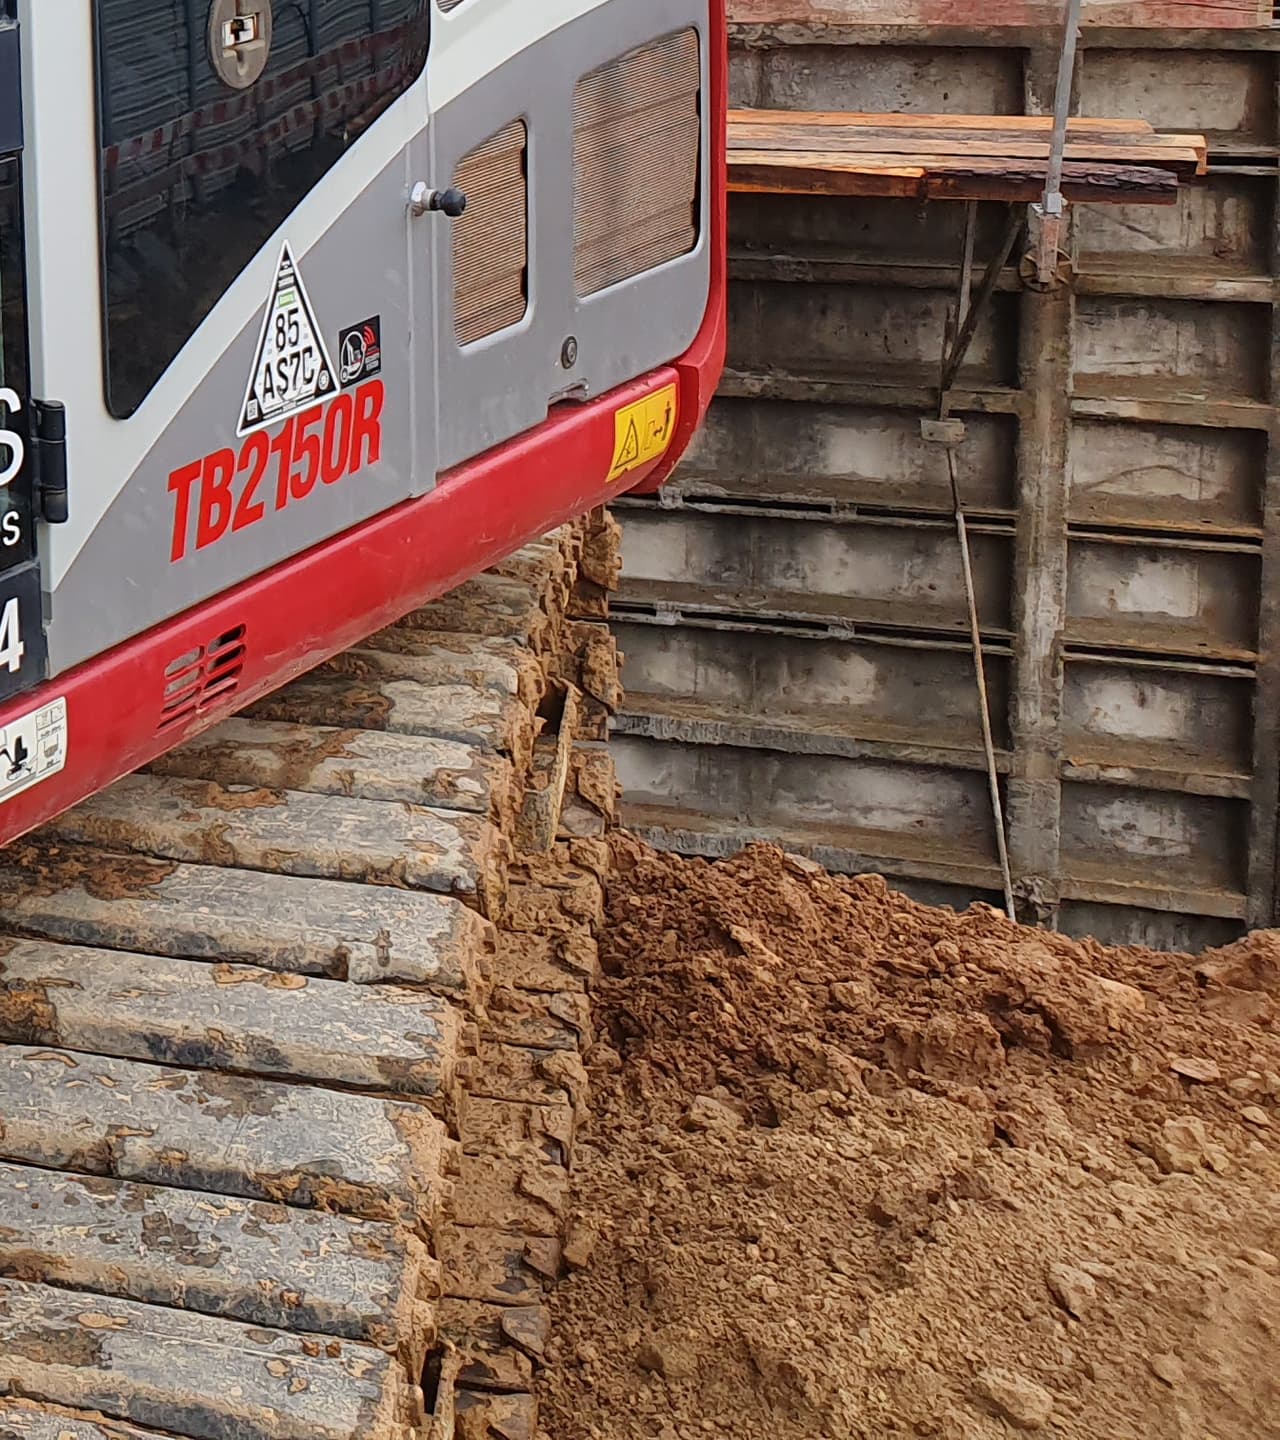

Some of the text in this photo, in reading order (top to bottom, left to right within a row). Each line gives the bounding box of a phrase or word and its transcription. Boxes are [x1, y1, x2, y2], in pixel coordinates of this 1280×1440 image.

[275, 307, 300, 352] 85
[262, 345, 316, 403] AS7C
[167, 378, 385, 564] TB2150R
